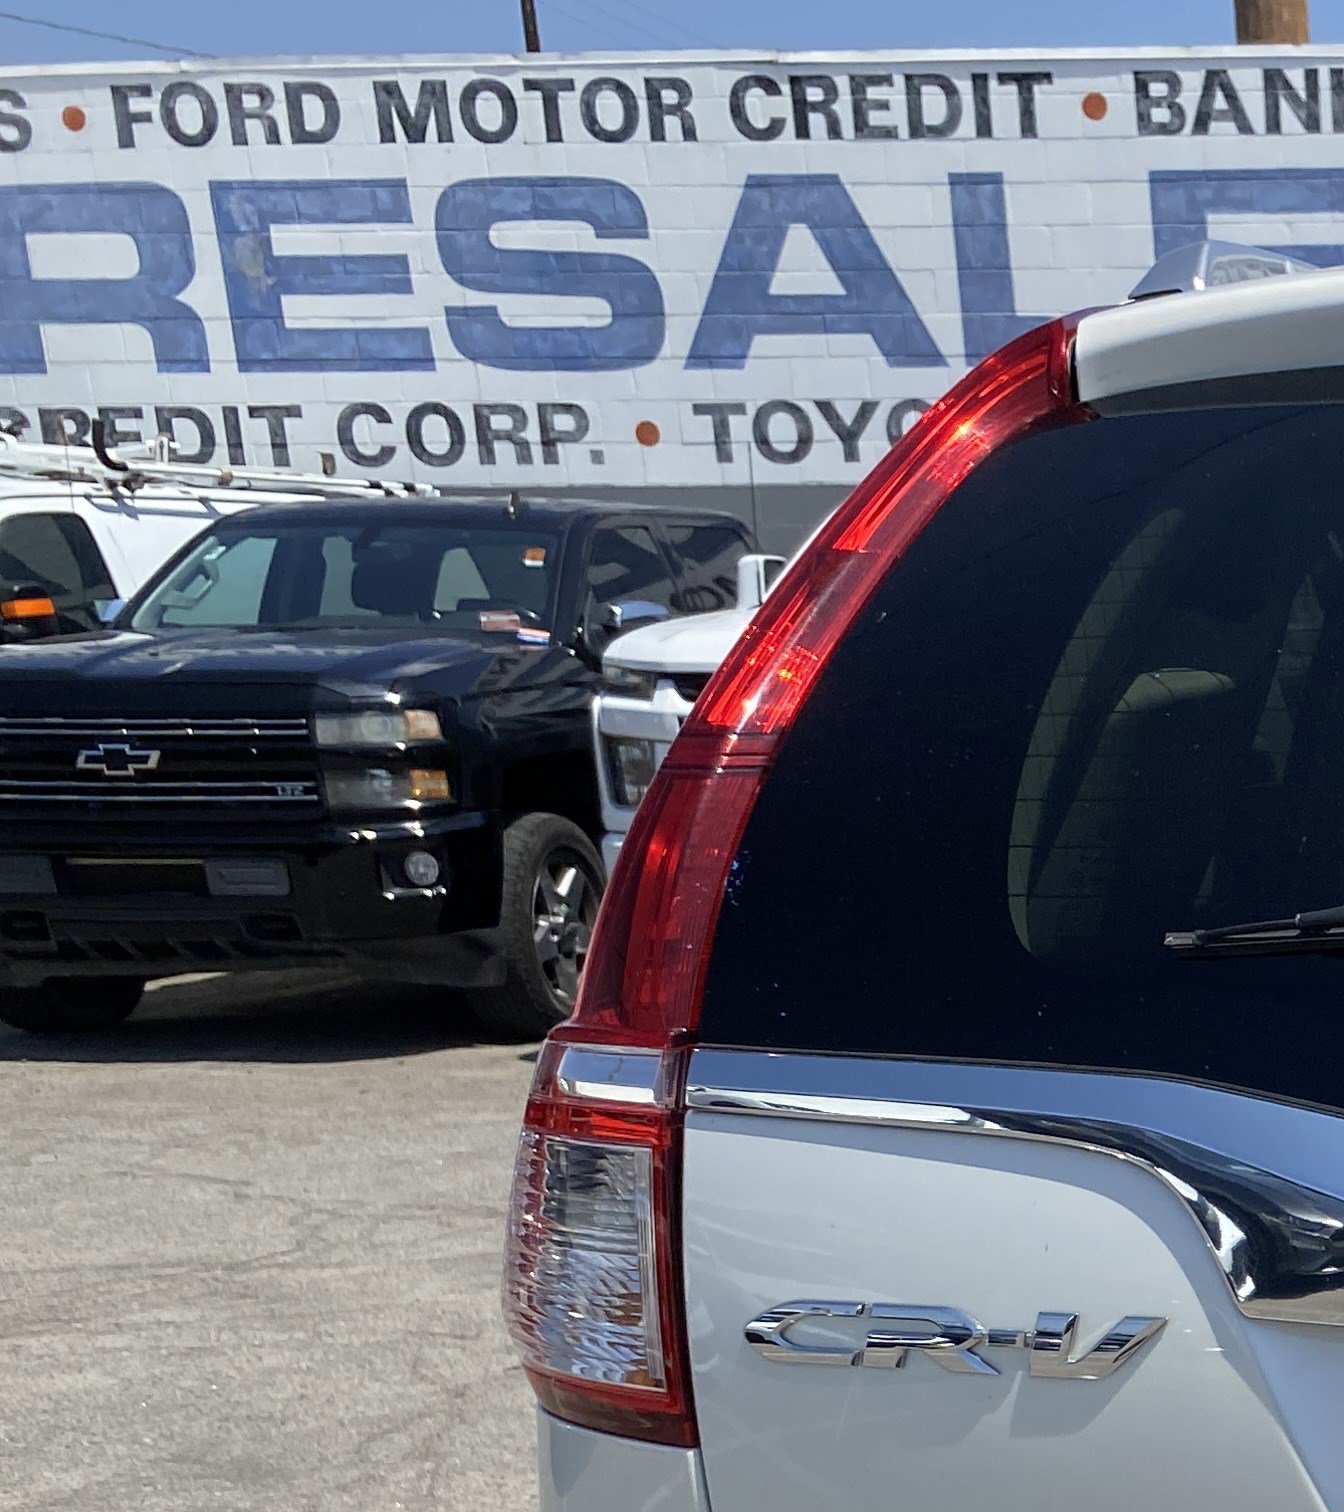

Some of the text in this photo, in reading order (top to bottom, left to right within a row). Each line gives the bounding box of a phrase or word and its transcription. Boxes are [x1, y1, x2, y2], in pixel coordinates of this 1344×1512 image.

[109, 80, 341, 149] FORD
[372, 76, 699, 145] MOTOR
[728, 71, 1054, 142] CREDIT
[0, 405, 302, 467] REDIT
[336, 401, 605, 467] CORP.
[744, 1299, 1170, 1380] CR-V
